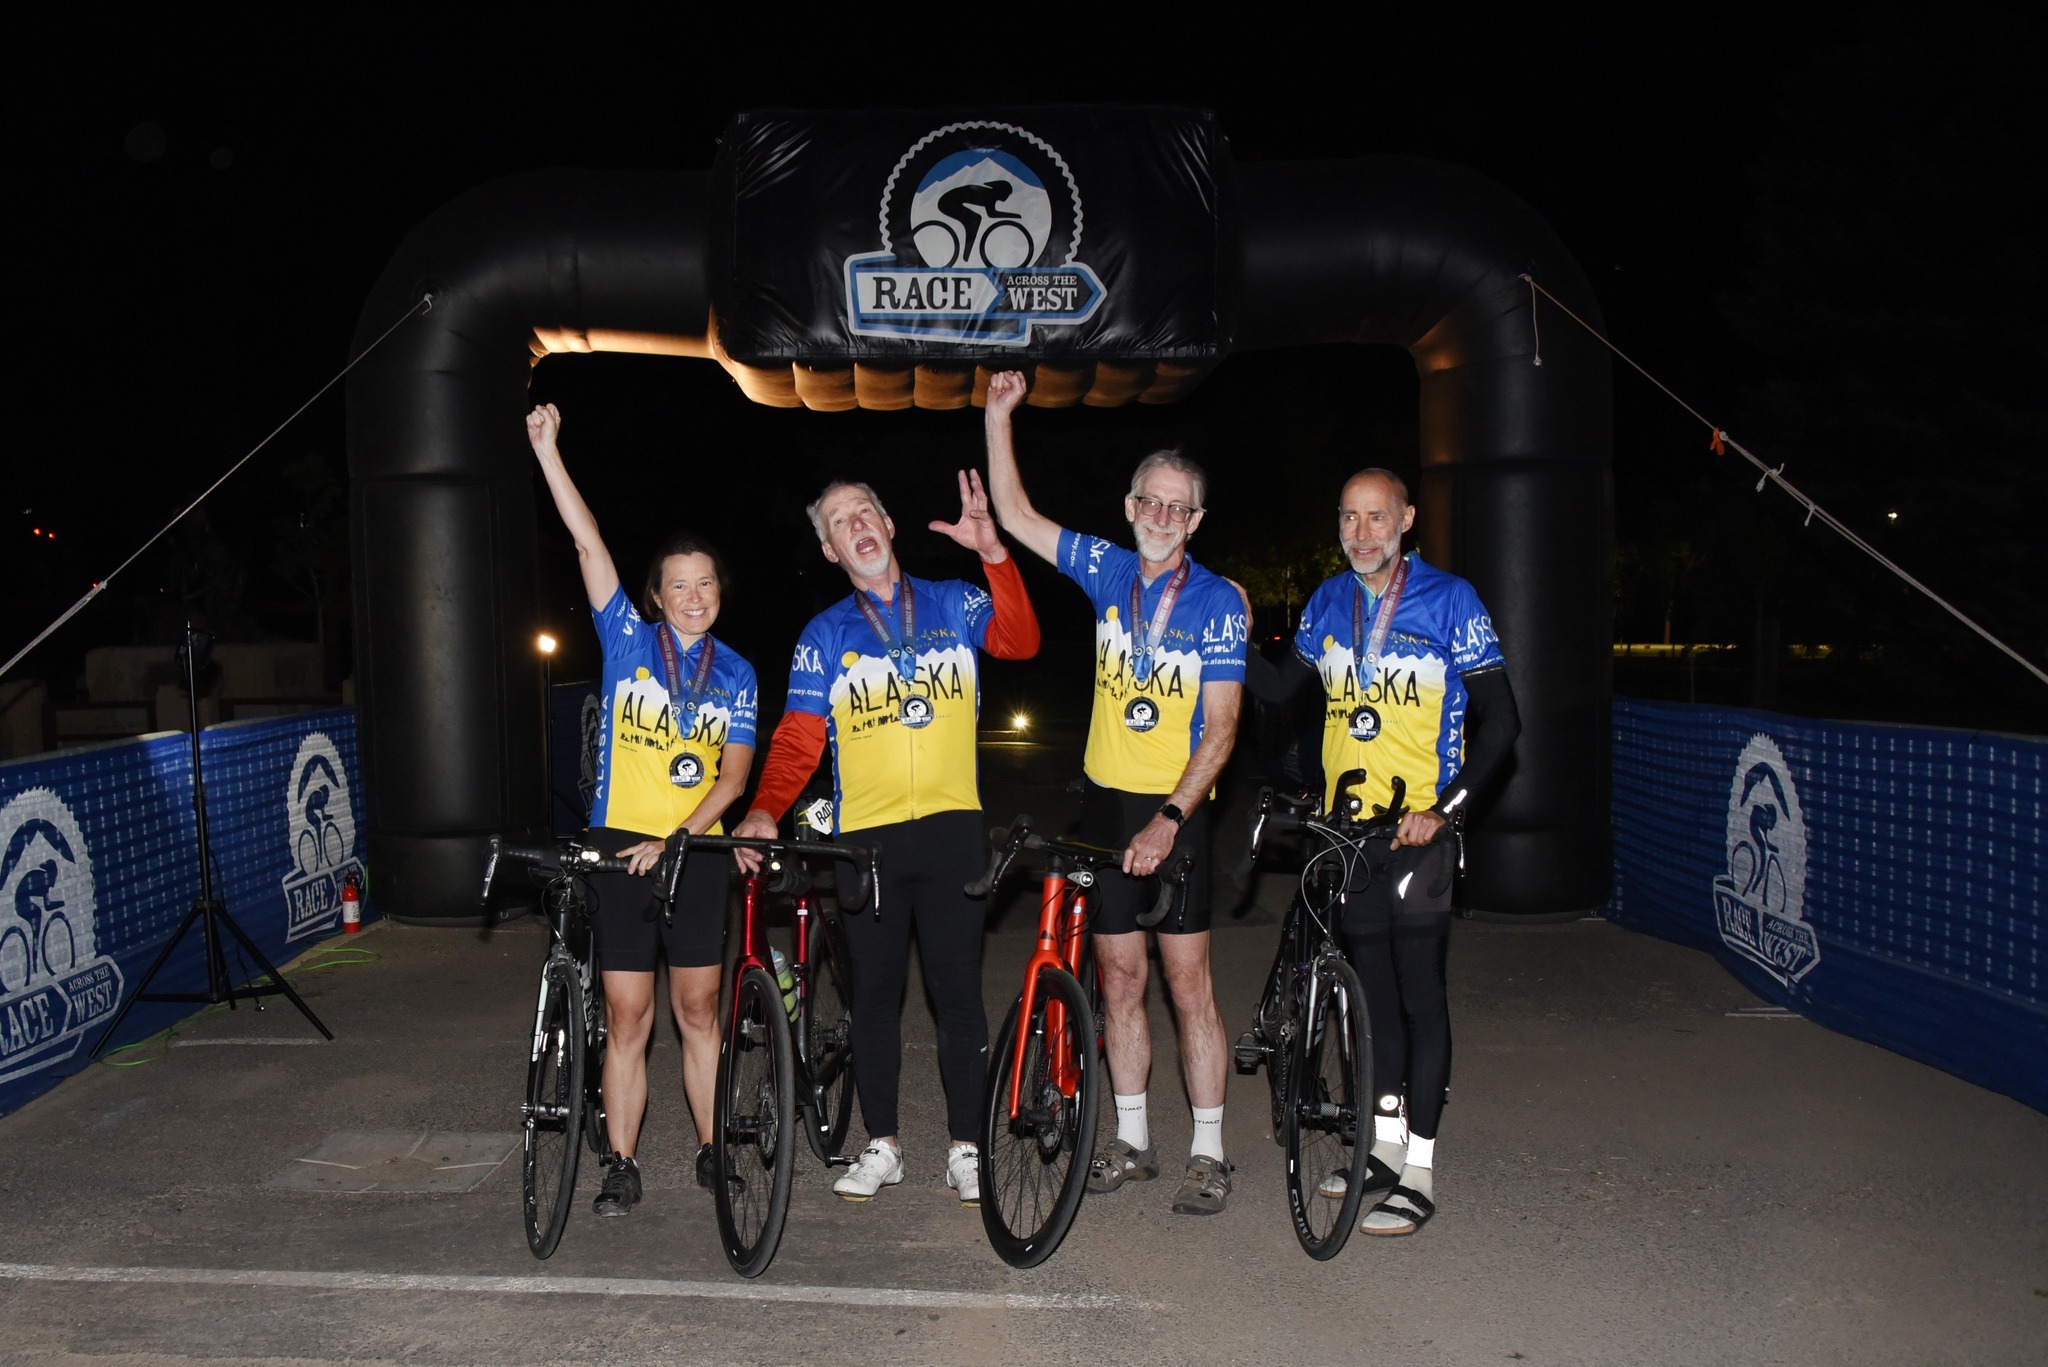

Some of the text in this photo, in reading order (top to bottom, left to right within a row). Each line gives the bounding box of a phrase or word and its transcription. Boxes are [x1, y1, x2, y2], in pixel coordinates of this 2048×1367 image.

[872, 276, 972, 310] RACE
[1007, 276, 1077, 286] ACROSS THE
[1007, 287, 1078, 311] WEST
[1384, 592, 1396, 615] ACROSS
[622, 690, 727, 748] ALAKA
[595, 694, 609, 800] ALASKA
[294, 878, 328, 923] RACE
[1722, 896, 1756, 946] RACE
[1766, 920, 1809, 943] ACROSS THE
[1764, 932, 1806, 971] WEST
[68, 966, 110, 992] ACROSS THE
[72, 981, 112, 1024] WEST
